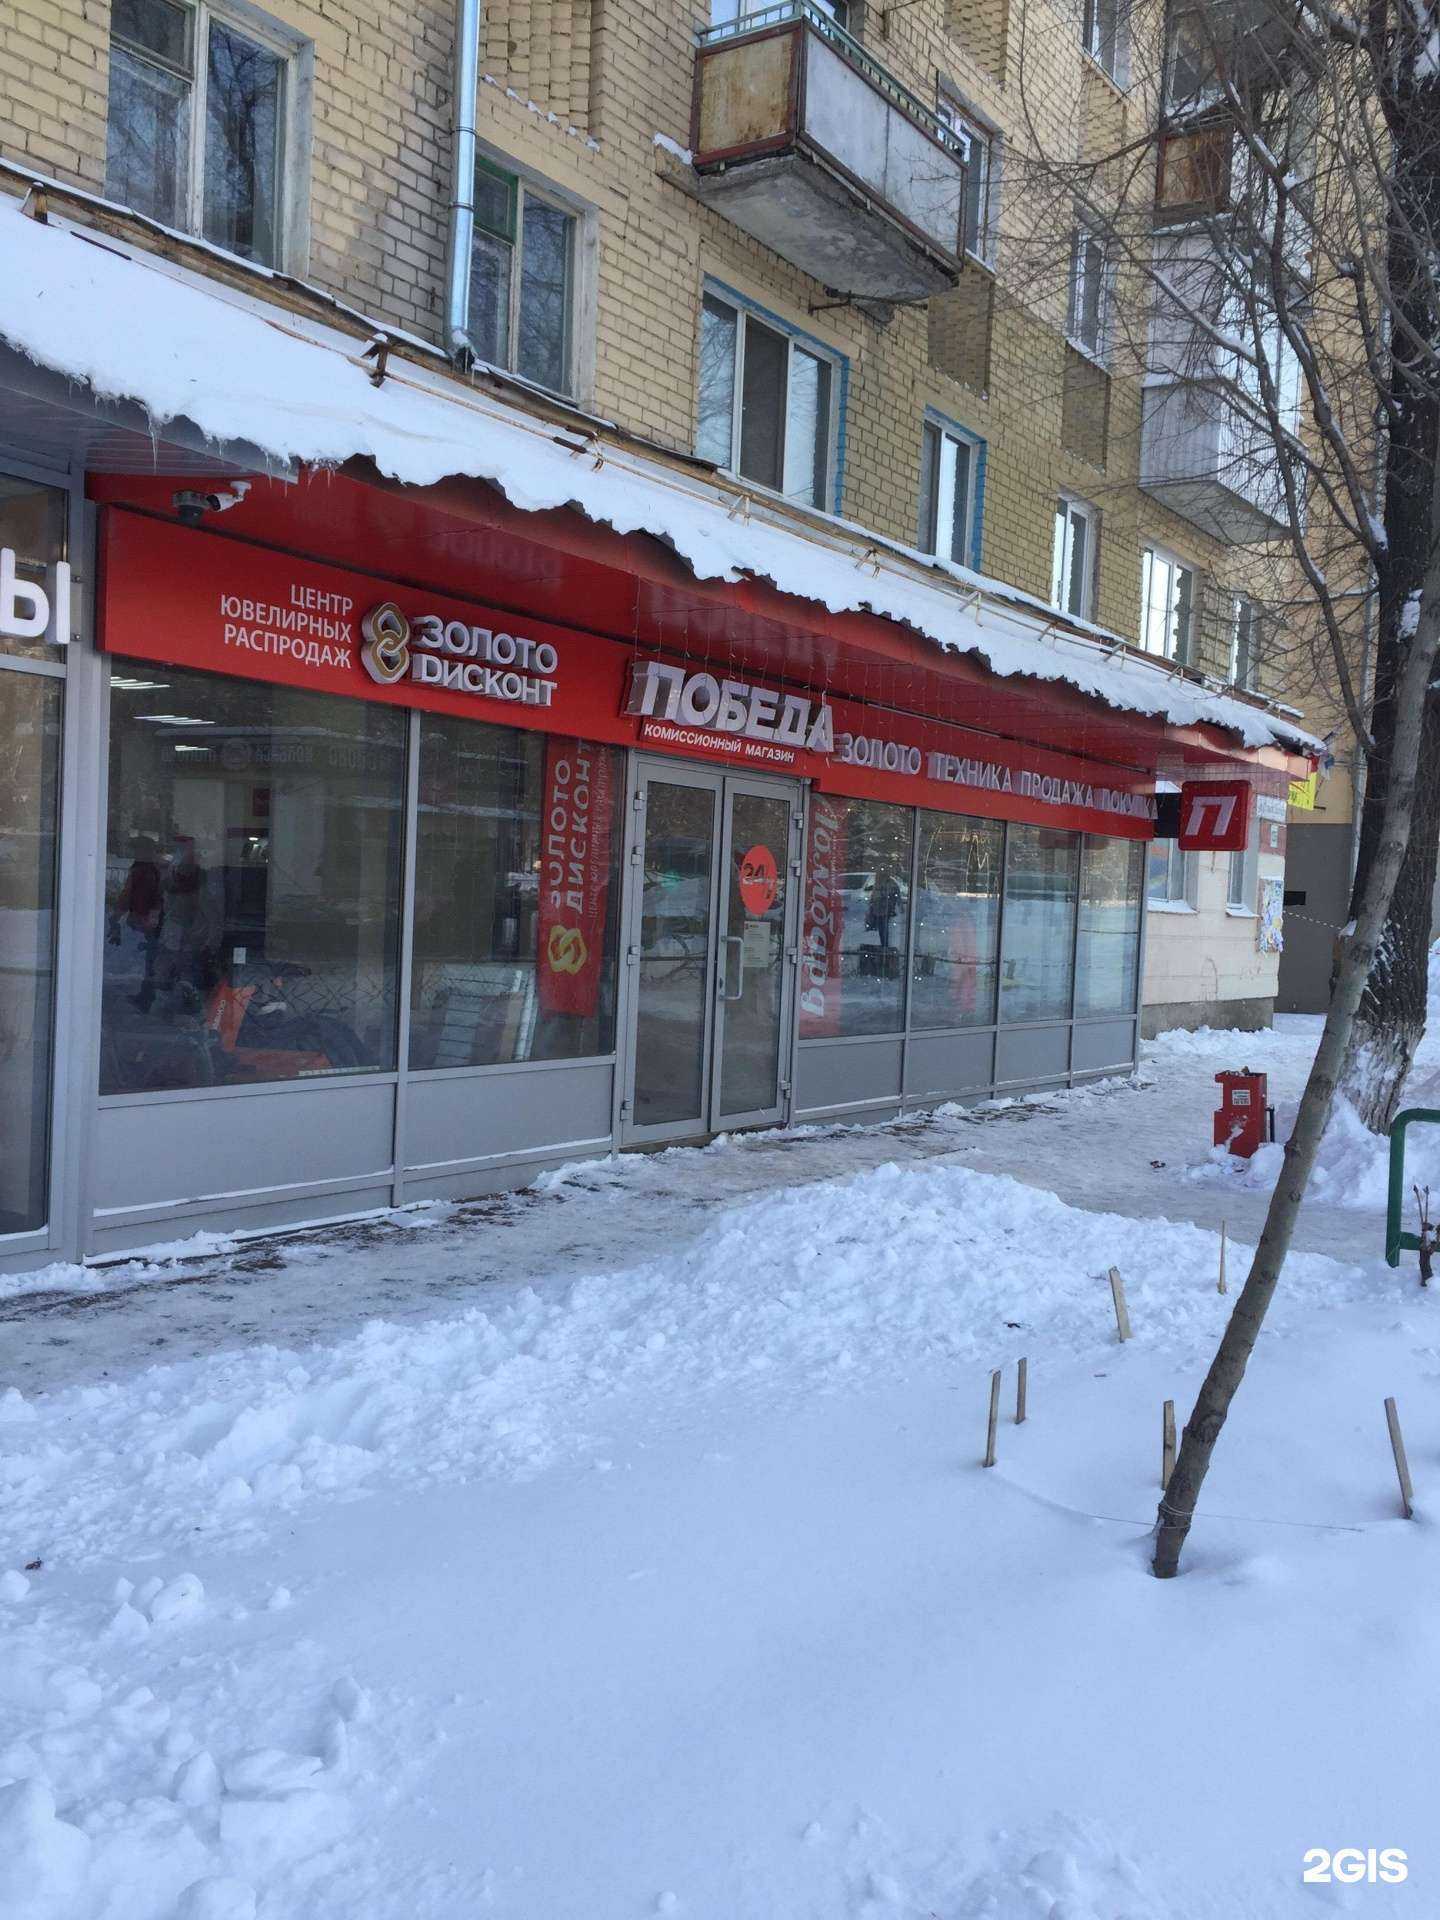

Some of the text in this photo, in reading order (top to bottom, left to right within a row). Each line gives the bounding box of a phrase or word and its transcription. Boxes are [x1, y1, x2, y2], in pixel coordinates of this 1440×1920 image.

[220, 594, 352, 643] ЮВЕЛИРНЫХ
[290, 584, 353, 616] ЦЕНТР
[224, 623, 351, 669] РАСПРОДАЖ
[416, 615, 558, 674] ЗОЛОТО
[636, 661, 834, 752] ПОБЕДА
[643, 724, 795, 763] КОМИССИОННЫЙ МАГАЗИН
[837, 732, 922, 775] ЗОЛОТО
[930, 752, 1013, 793] ТЕХНИКА
[1018, 770, 1094, 808] ПРОДАЖА
[1185, 795, 1237, 836] П
